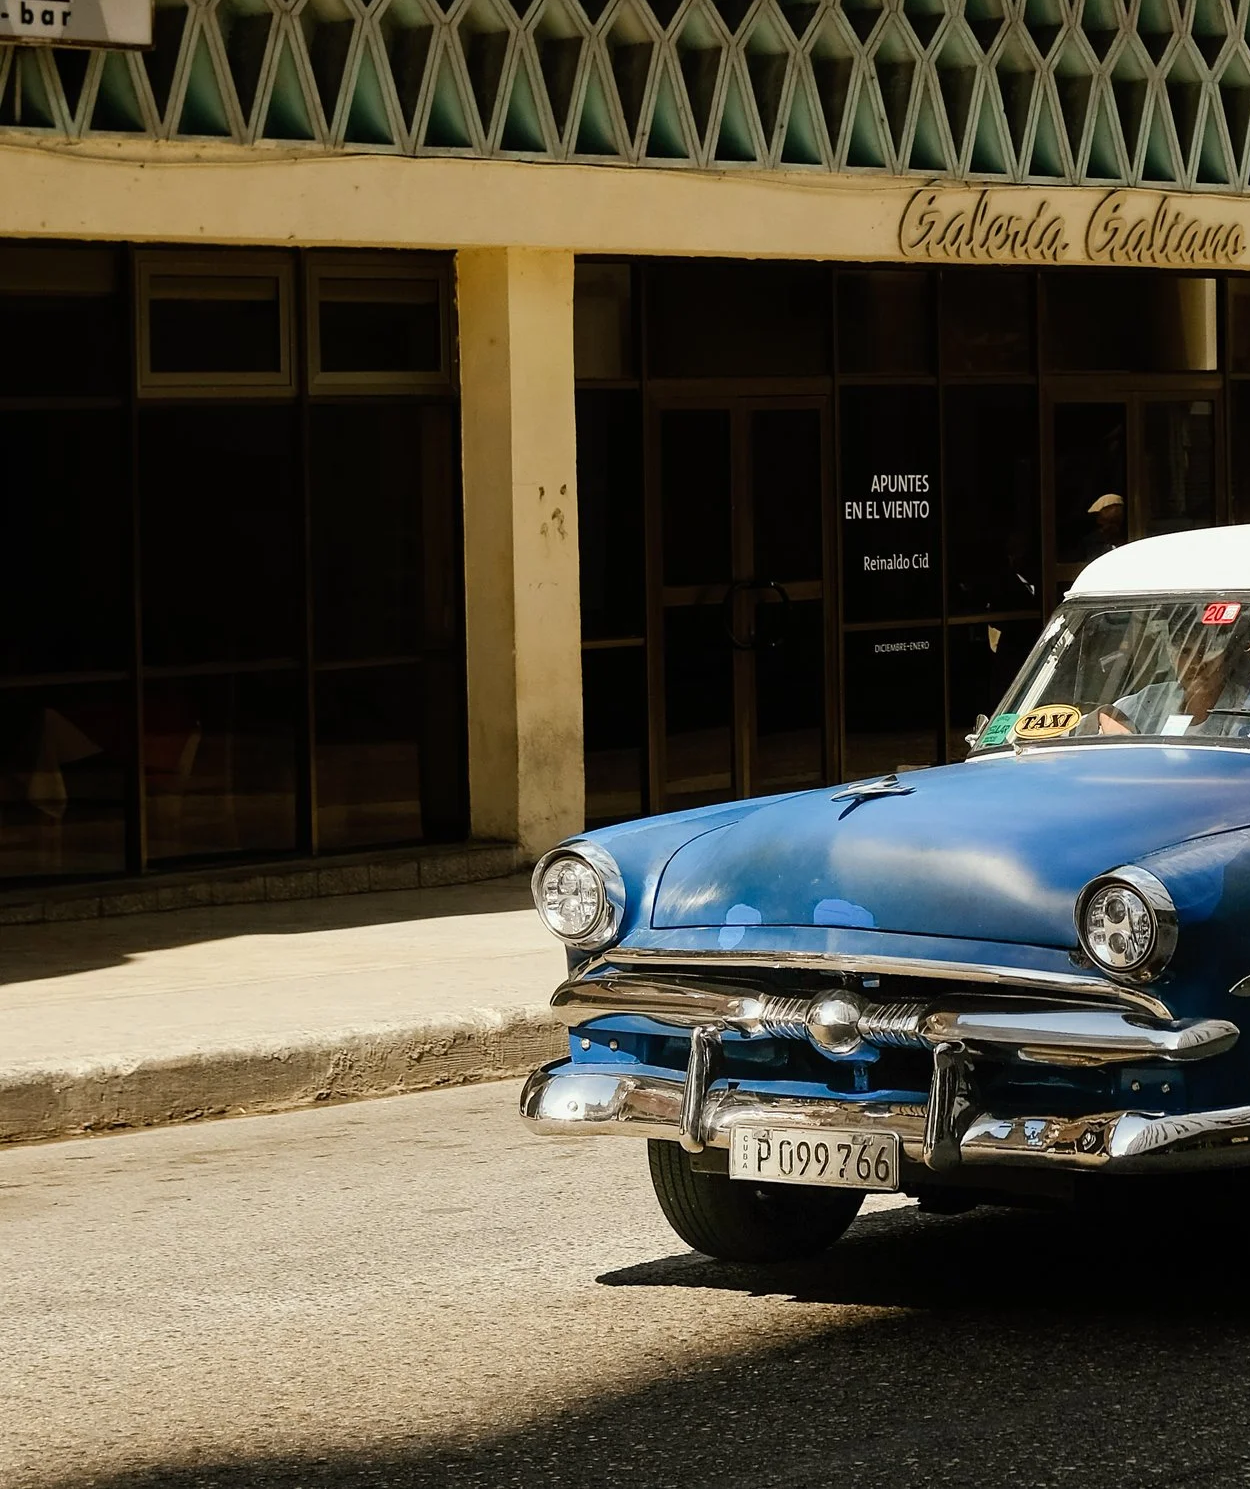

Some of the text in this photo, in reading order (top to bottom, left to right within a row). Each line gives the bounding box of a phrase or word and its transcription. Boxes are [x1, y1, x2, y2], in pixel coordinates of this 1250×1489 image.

[1084, 187, 1247, 264] Galiano
[871, 474, 930, 493] APUNTES
[845, 500, 930, 520] EN EL VIENTO
[863, 552, 930, 571] Reinaldo Cid
[1021, 713, 1074, 731] TAXI
